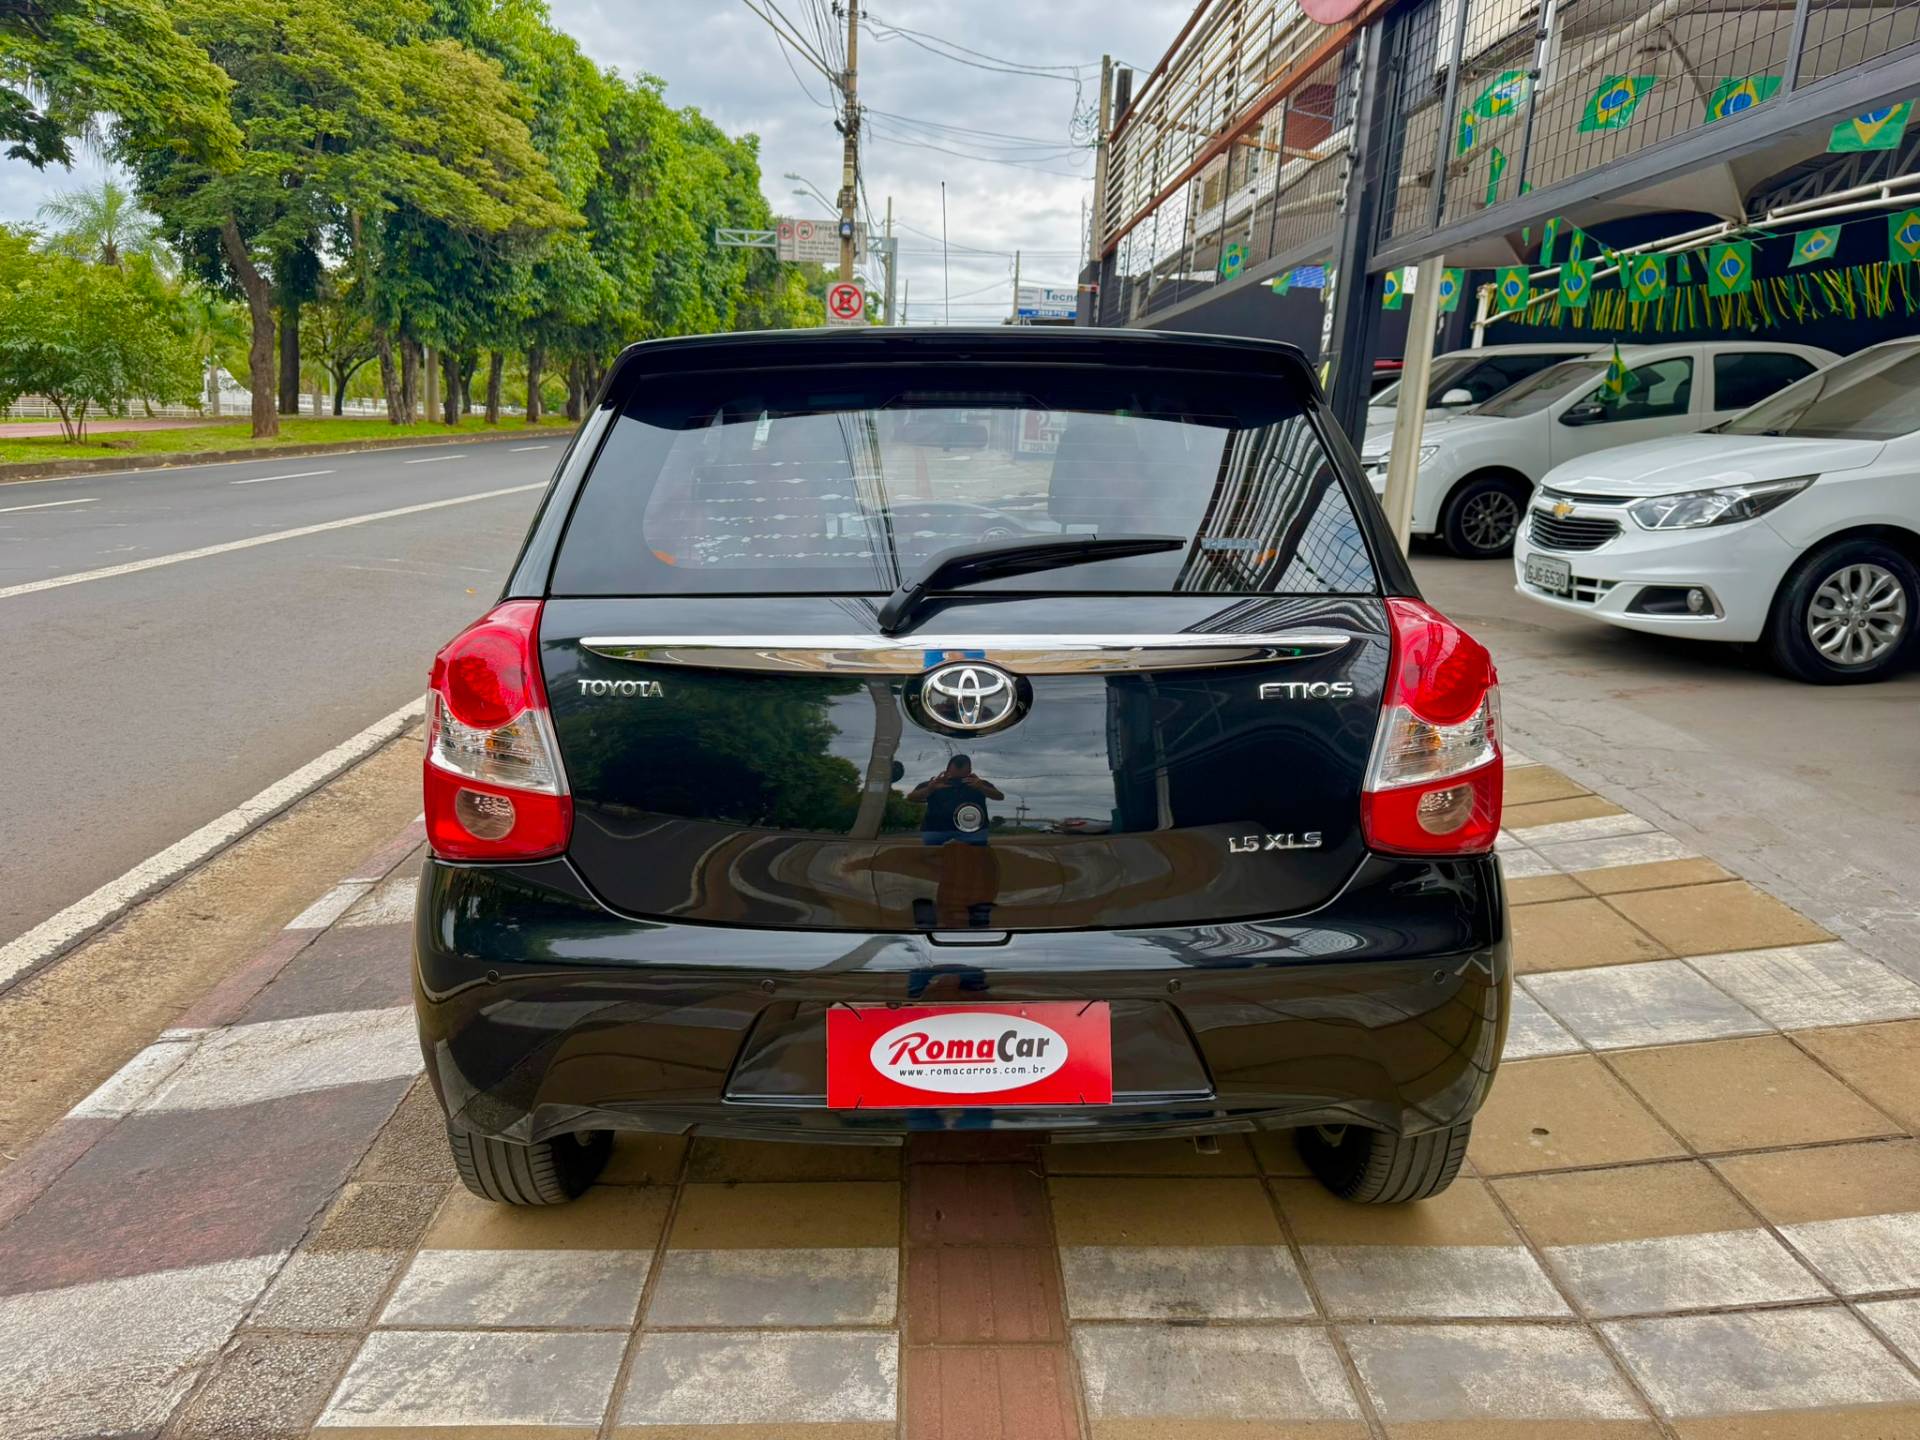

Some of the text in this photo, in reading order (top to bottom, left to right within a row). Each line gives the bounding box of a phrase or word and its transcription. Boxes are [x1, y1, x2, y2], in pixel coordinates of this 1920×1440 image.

[577, 679, 664, 698] TOYOTA
[1259, 681, 1354, 700] ETIOS
[1264, 831, 1322, 851] XLS
[888, 1029, 1050, 1066] RomaCar
[899, 1064, 1046, 1077] www.romacarros.com.br
